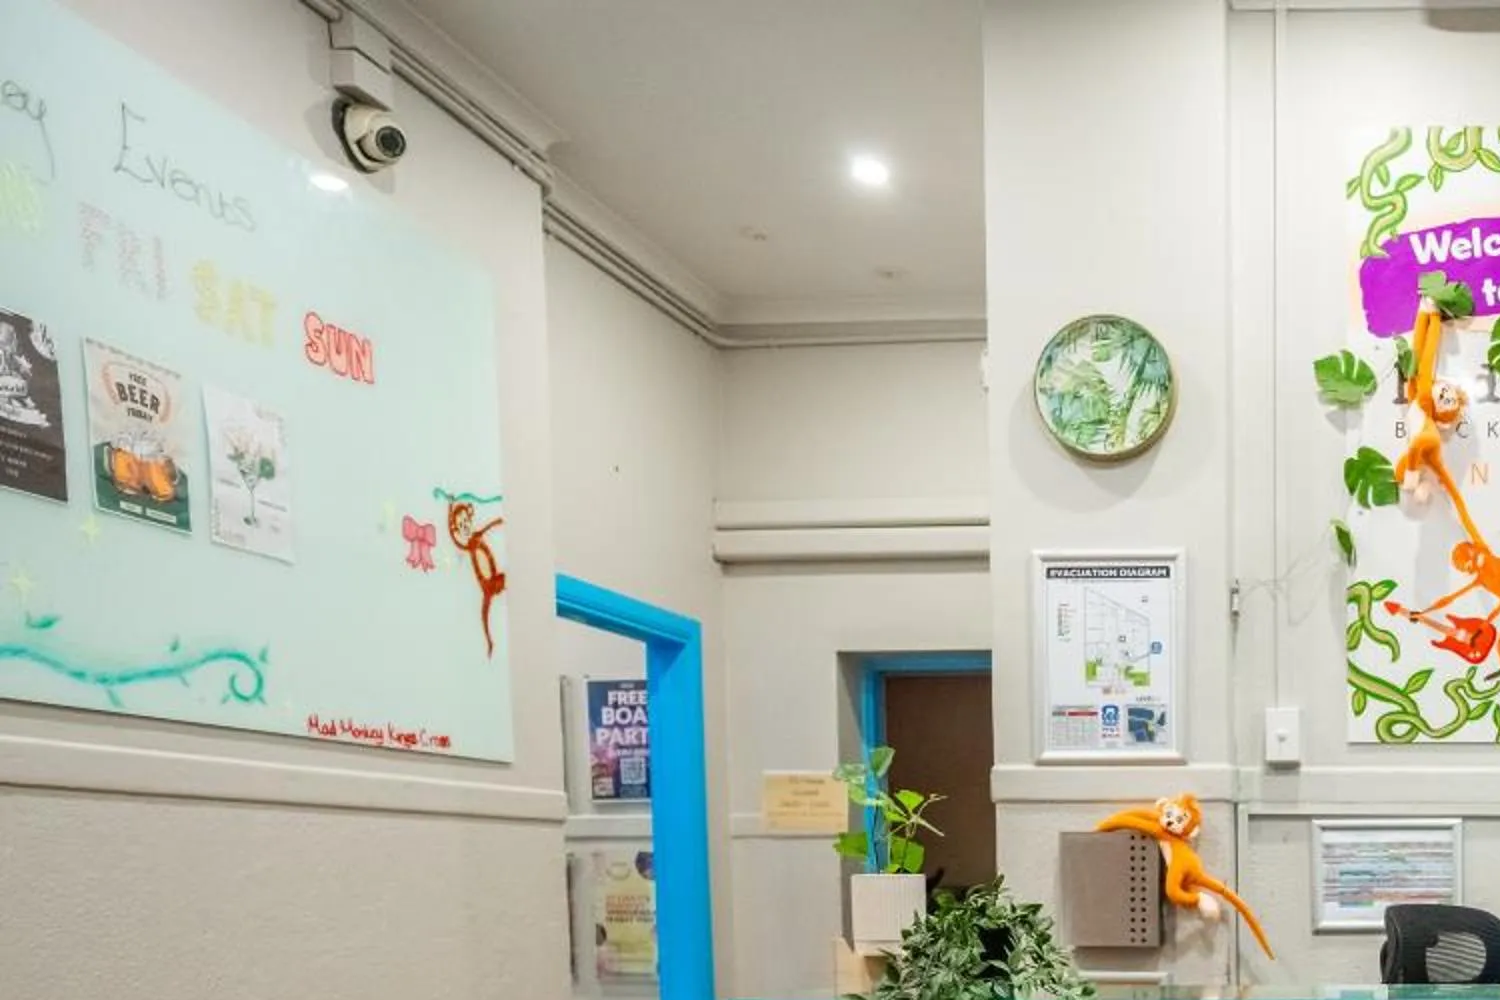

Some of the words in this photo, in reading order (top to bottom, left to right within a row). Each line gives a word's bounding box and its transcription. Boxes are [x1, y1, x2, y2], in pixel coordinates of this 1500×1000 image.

[113, 102, 258, 232] Events
[303, 311, 375, 385] SUN
[115, 381, 161, 414] BEER
[1049, 567, 1117, 578] EVACUATION
[1119, 566, 1167, 577] DIAGRAM
[607, 689, 649, 705] FREE
[307, 713, 337, 737] Mad
[601, 705, 649, 726] BOA
[595, 727, 649, 746] PART
